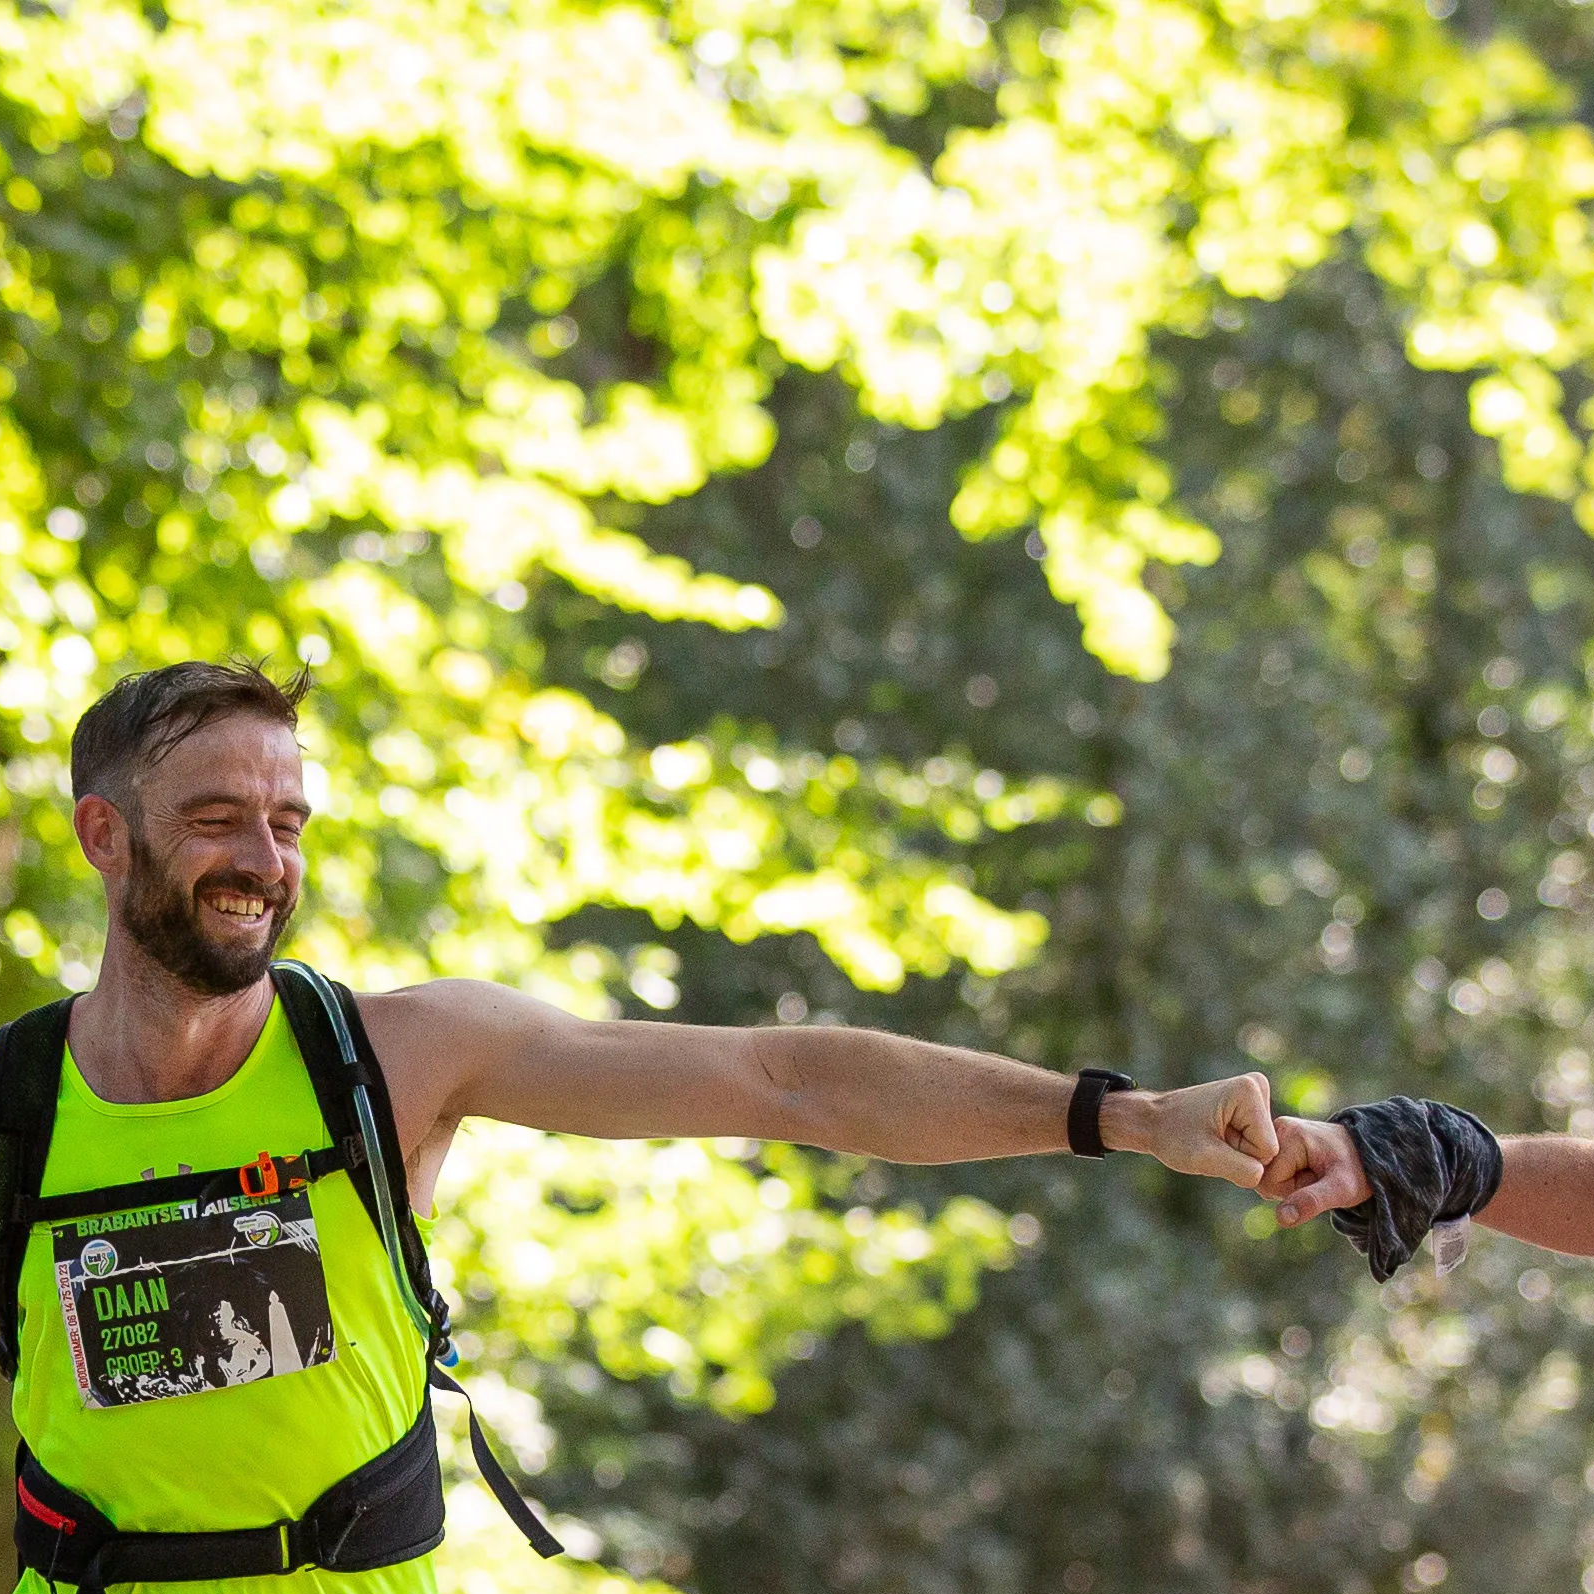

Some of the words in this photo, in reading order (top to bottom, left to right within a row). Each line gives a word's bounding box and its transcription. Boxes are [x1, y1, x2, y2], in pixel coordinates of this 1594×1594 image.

[58, 1263, 68, 1276] 23
[60, 1278, 70, 1288] 20
[92, 1277, 169, 1322] DAAN
[101, 1321, 160, 1351] 27082
[106, 1351, 167, 1380] GROEP:
[172, 1347, 184, 1368] 3
